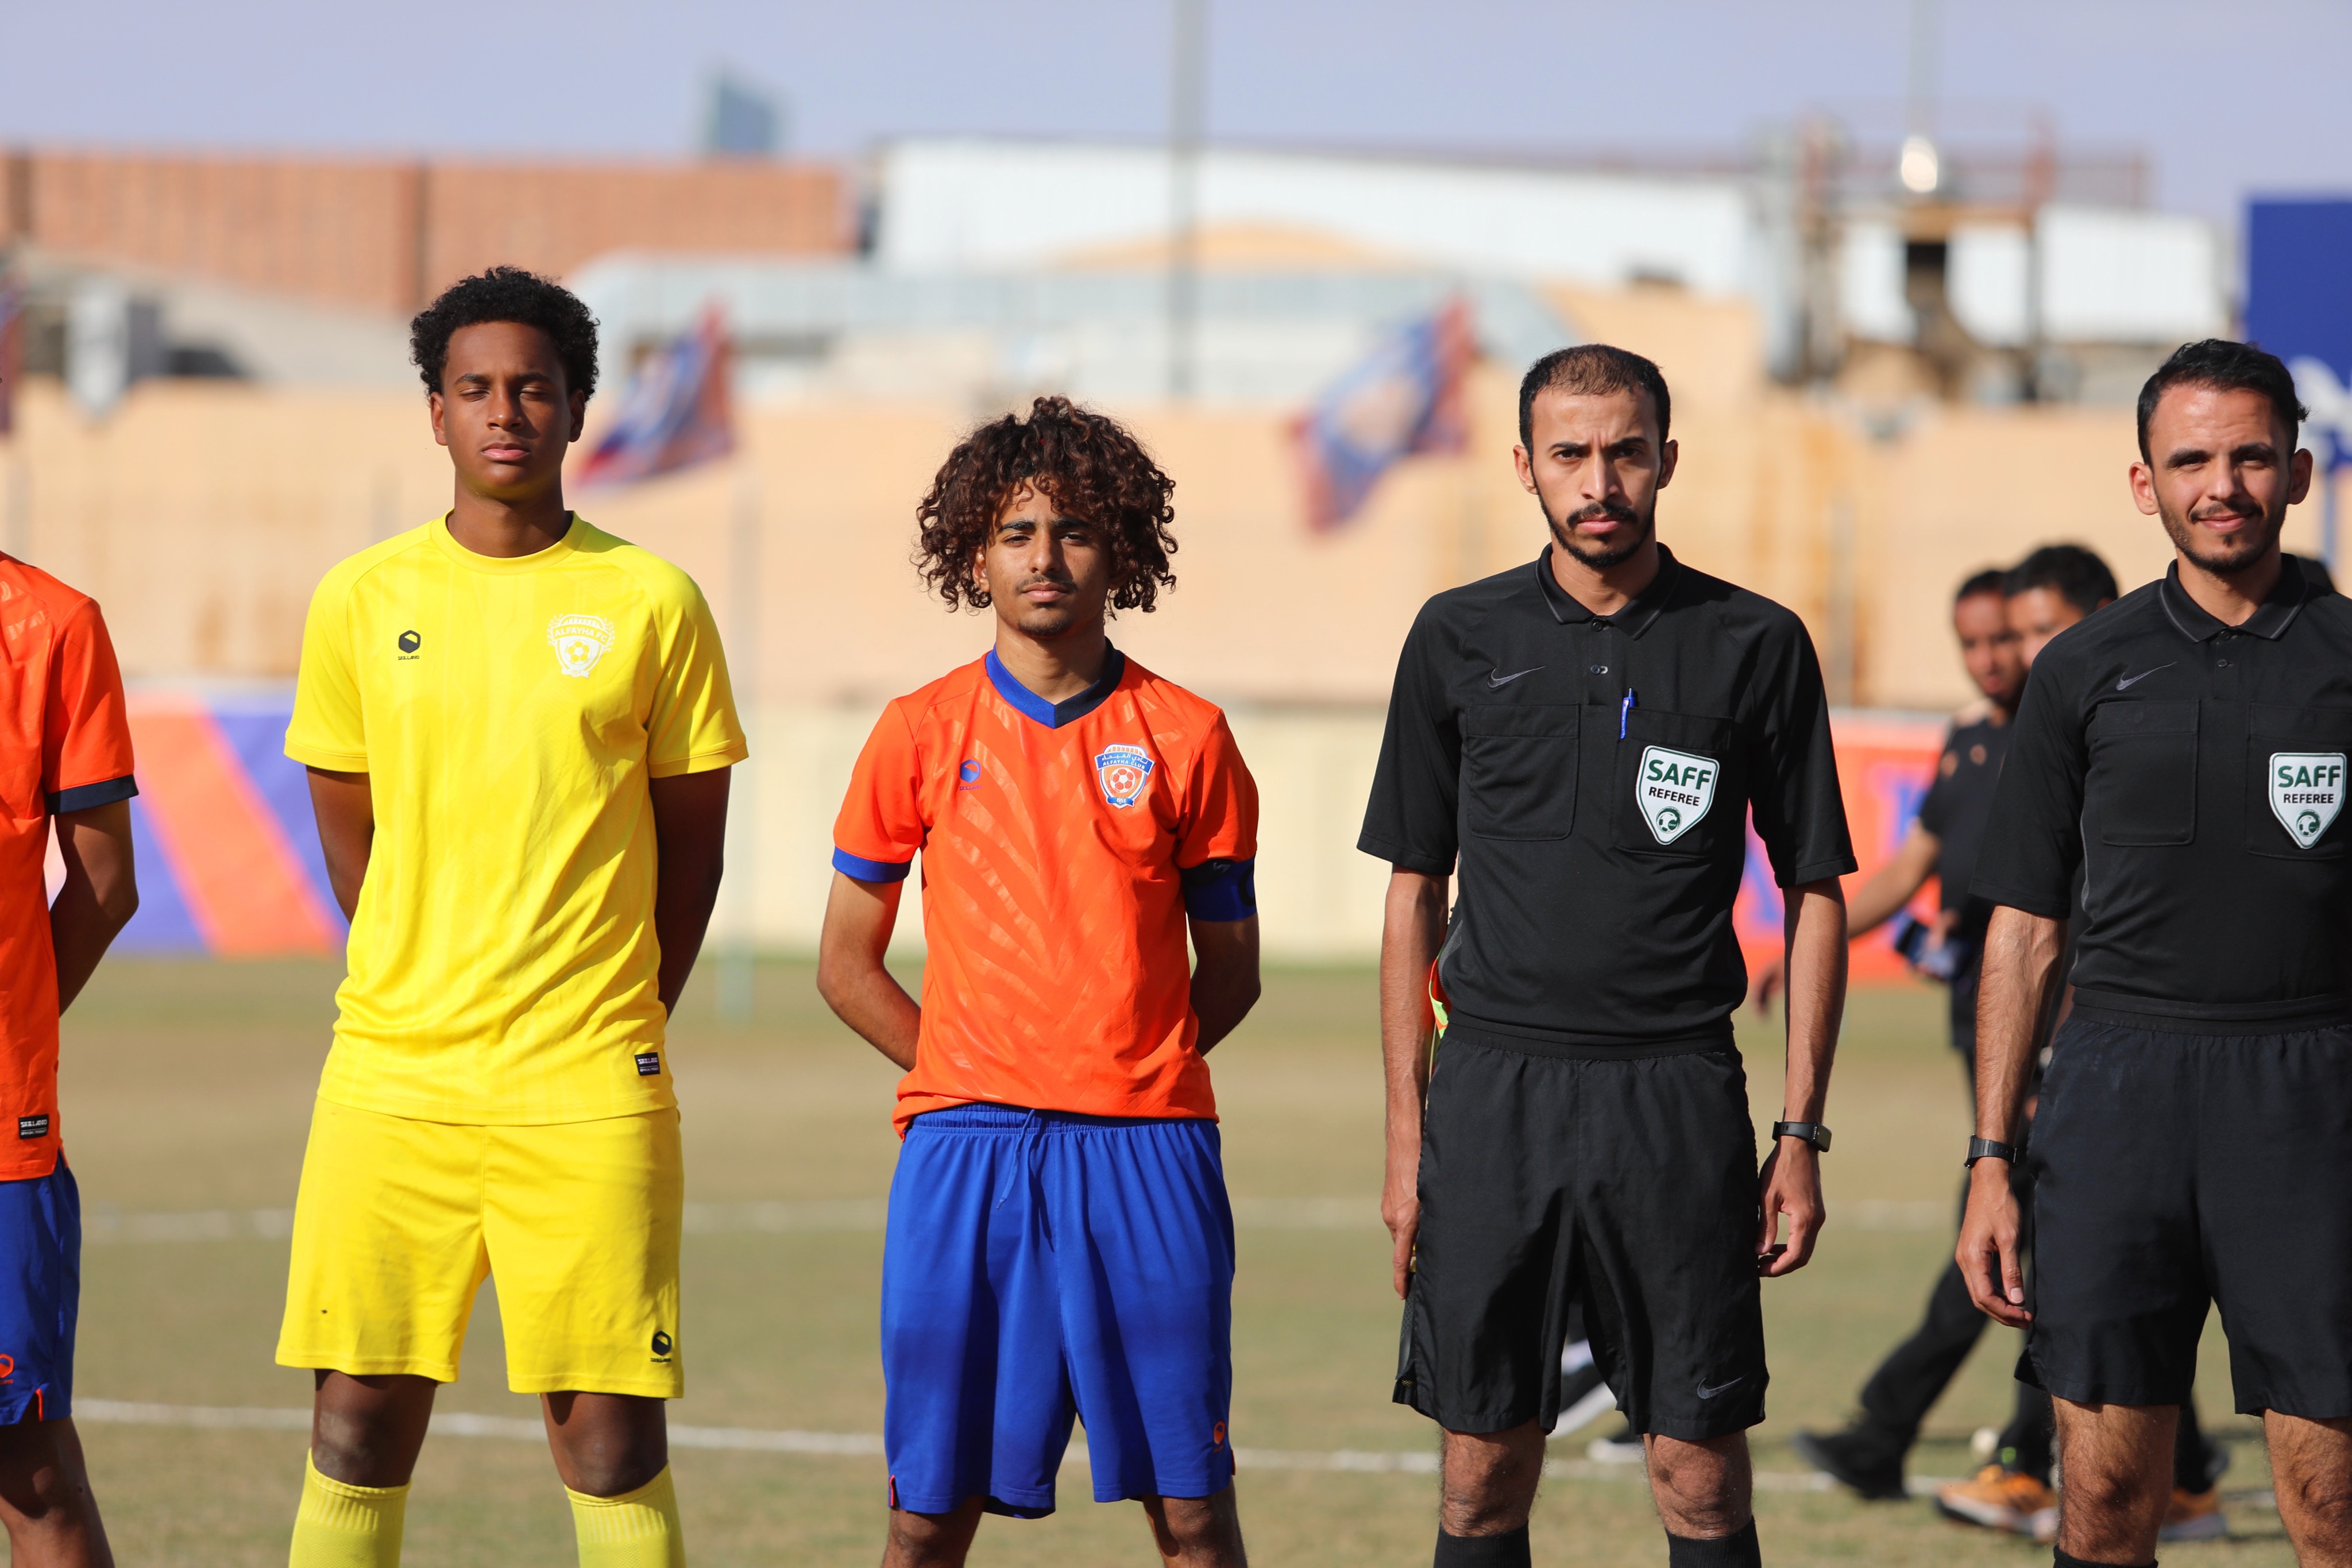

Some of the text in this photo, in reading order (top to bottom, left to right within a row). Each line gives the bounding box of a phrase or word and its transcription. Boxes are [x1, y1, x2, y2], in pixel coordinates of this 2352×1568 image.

[555, 627, 608, 642] ALFAYHA FC
[1130, 761, 1145, 770] CLUB
[1647, 759, 1712, 790] SAFF
[2277, 765, 2341, 787] SAFF
[1648, 786, 1700, 806] REFEREE
[2283, 793, 2334, 804] REFEREE
